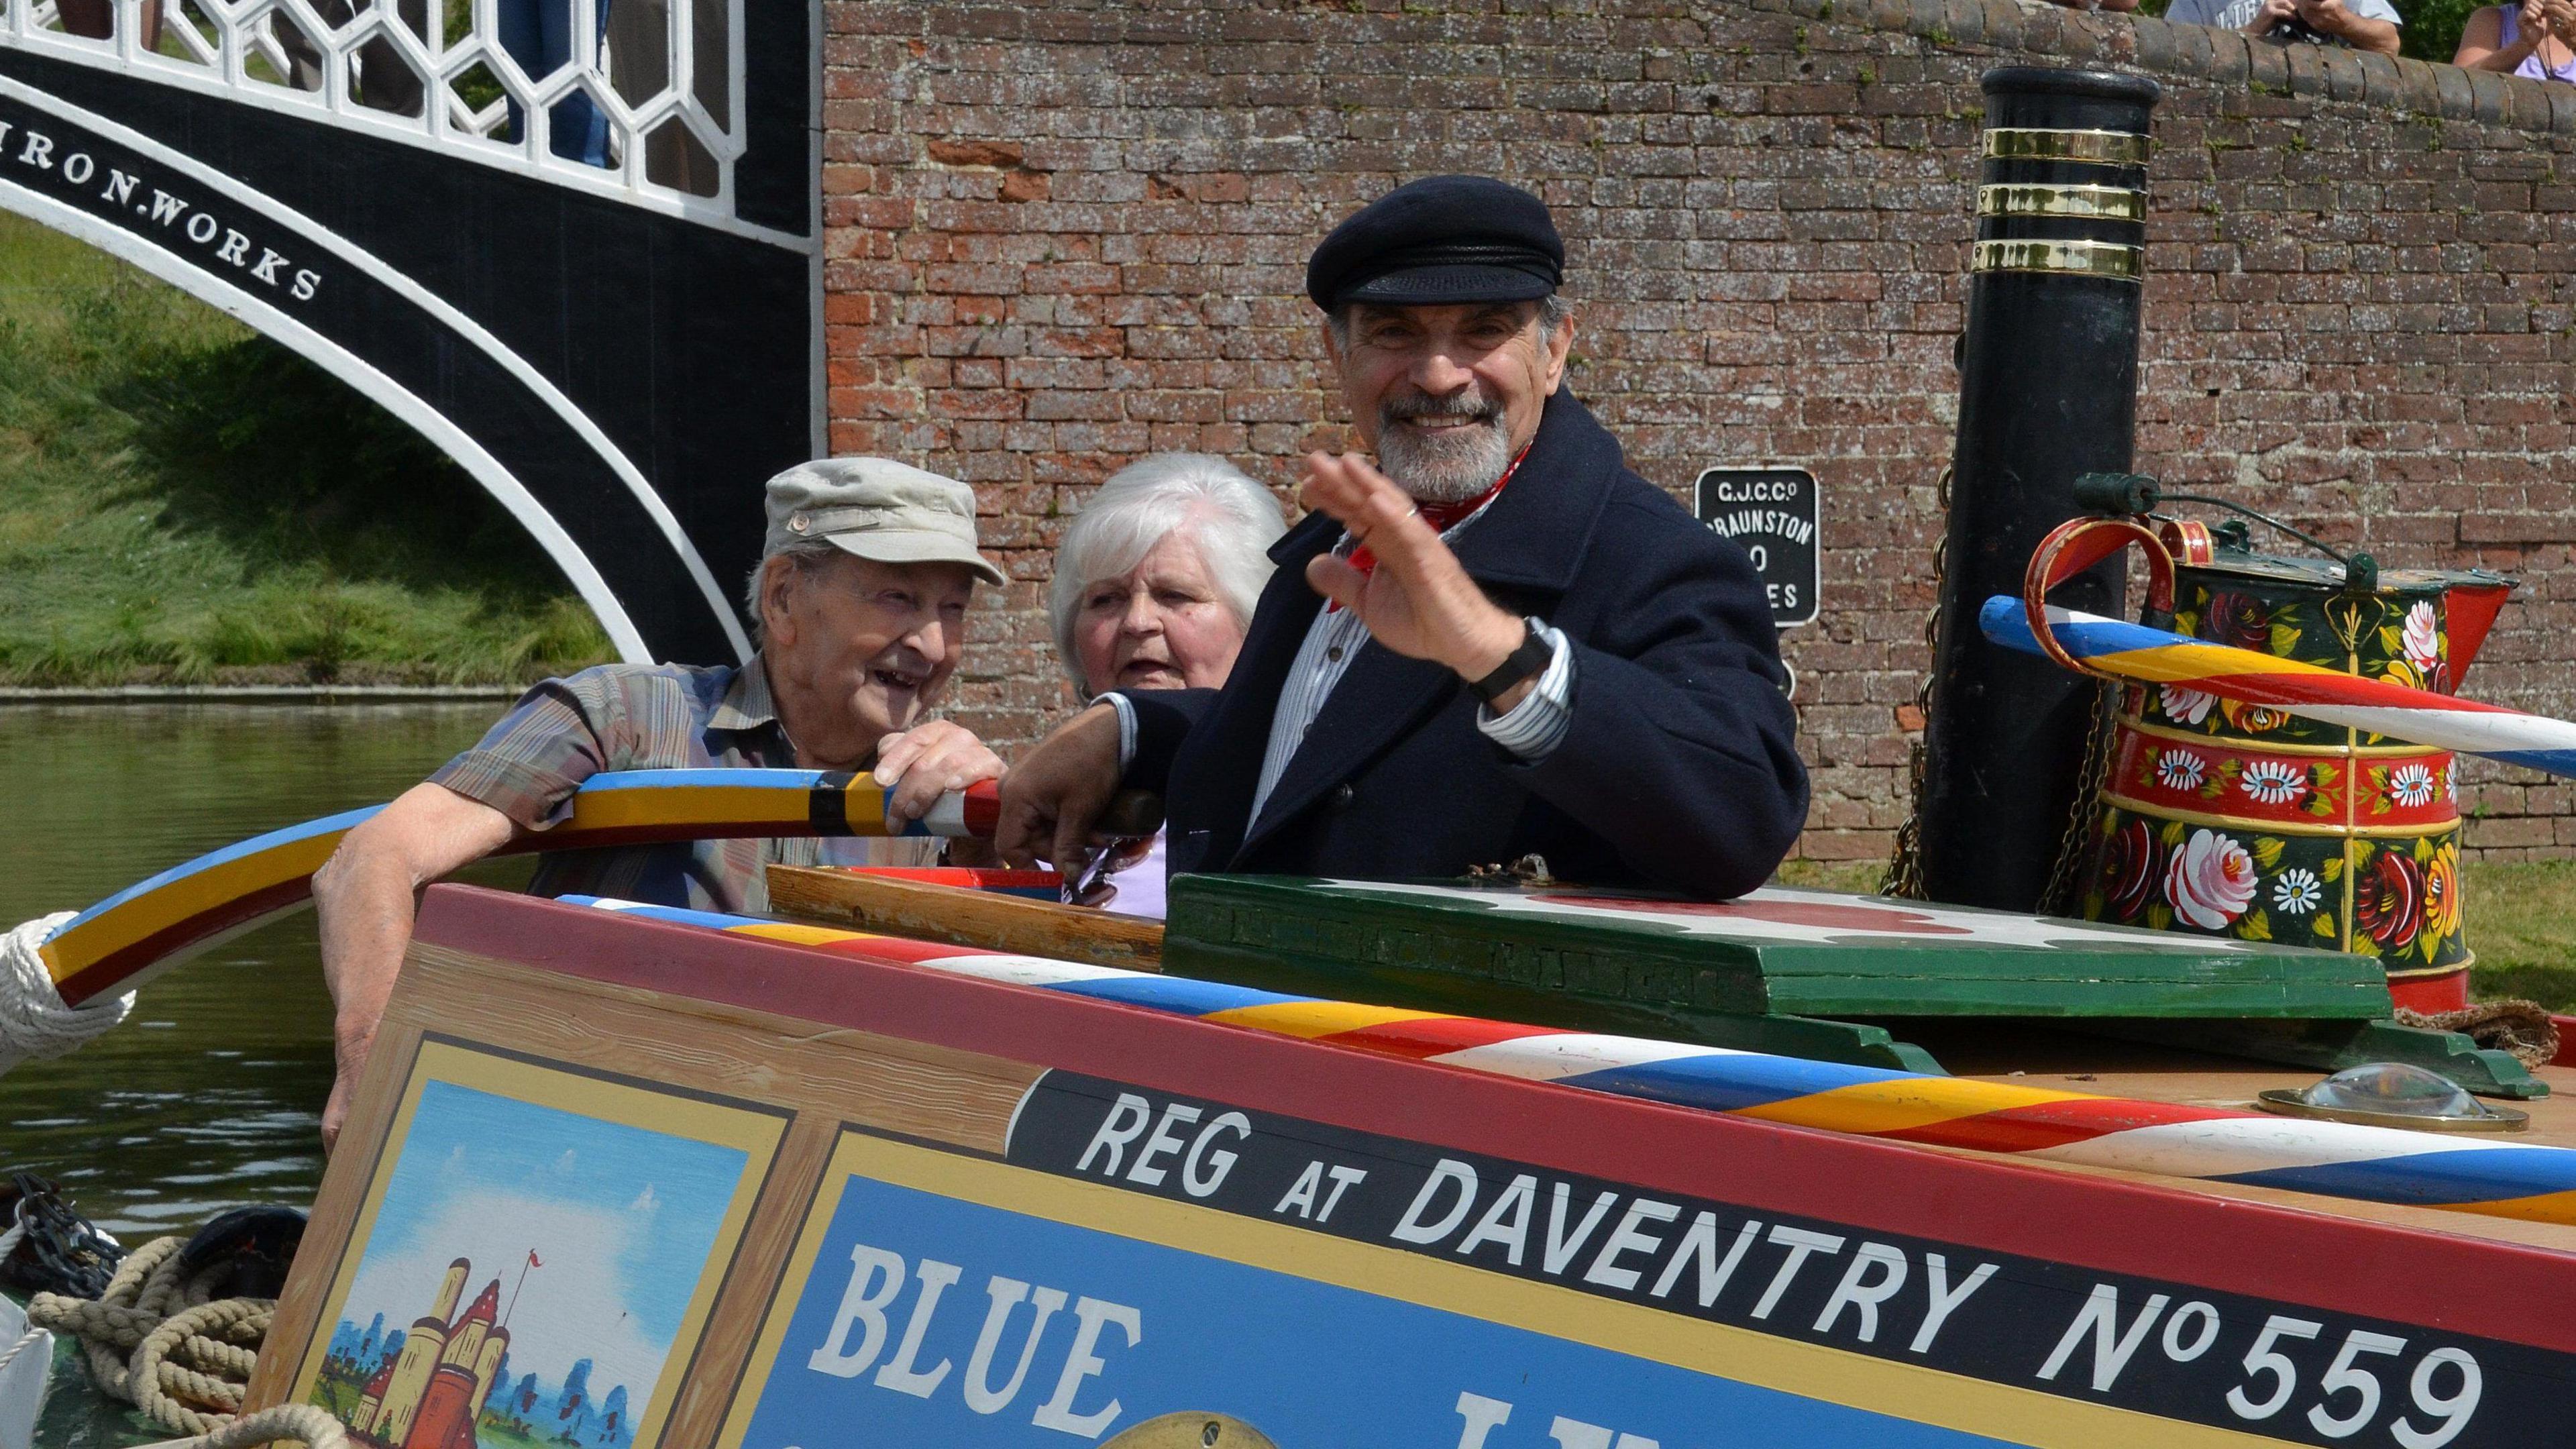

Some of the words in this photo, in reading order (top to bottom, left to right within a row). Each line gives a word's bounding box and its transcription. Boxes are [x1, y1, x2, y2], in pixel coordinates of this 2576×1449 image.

[1706, 509, 1813, 545] RAUNSTON
[807, 1243, 1142, 1439] BLUE
[1075, 1093, 1251, 1197] REG
[1273, 1161, 1368, 1222] AT
[1389, 1159, 2000, 1353] DAVENTRY
[2225, 1315, 2483, 1449] 559
